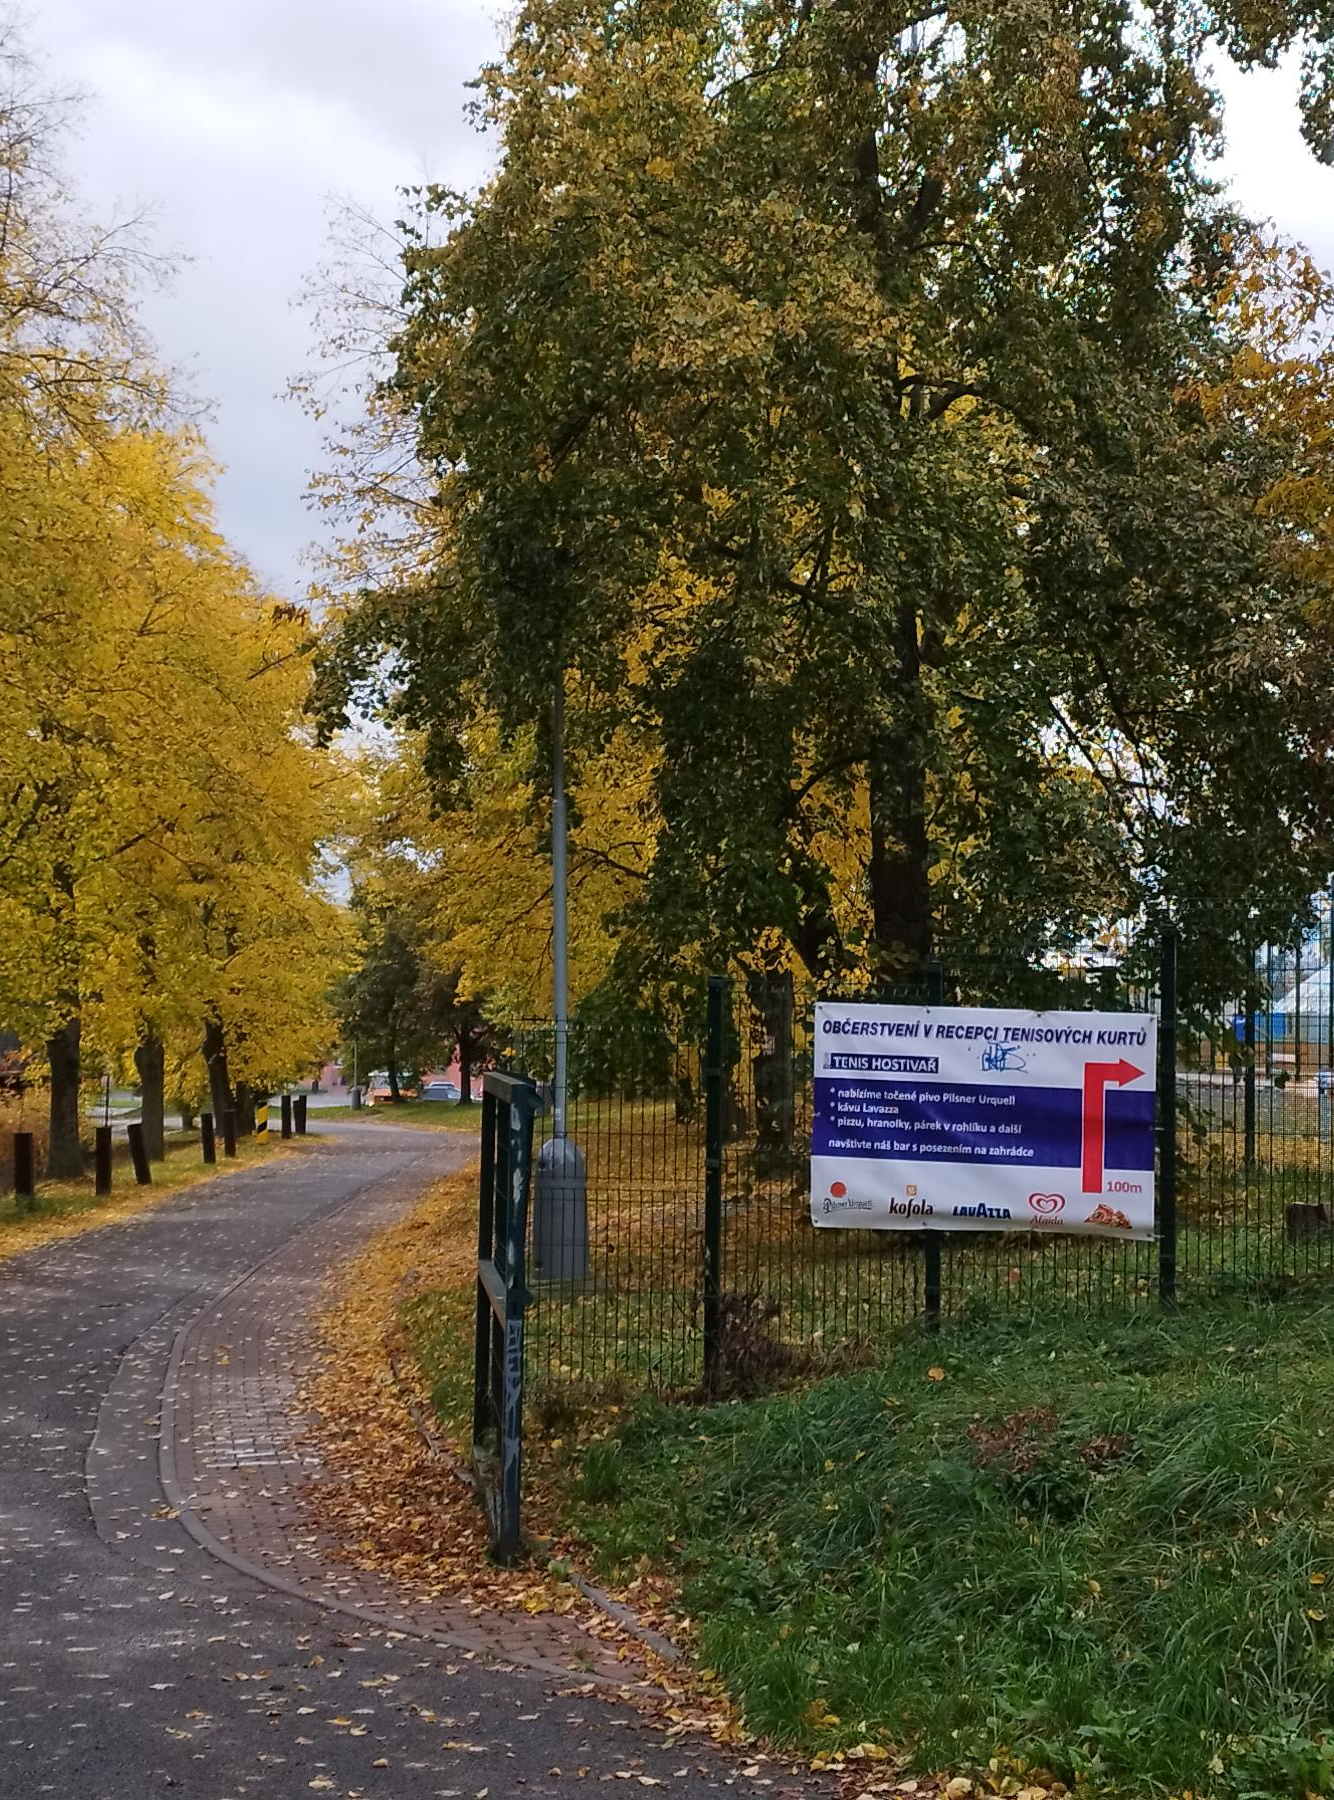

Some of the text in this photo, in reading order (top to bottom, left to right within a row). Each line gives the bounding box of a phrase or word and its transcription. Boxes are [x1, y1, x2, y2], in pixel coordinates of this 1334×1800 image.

[822, 1018, 1147, 1046] OBČERSTVENÍ V RECEPCI TENISOVÝCH KURTŮ
[833, 1056, 937, 1073] TENIS HOSTIVAŘ
[837, 1088, 1016, 1107] nabízíme točené pivo Pilsner Urquell
[837, 1102, 899, 1114] kávu Lavazza
[837, 1117, 1022, 1134] pizzu, hranolky, párek v rohlíku a další
[873, 1139, 892, 1150] náš
[893, 1140, 909, 1151] bar
[911, 1144, 918, 1152] s
[919, 1143, 972, 1154] posezením
[974, 1147, 987, 1155] na
[988, 1146, 1035, 1157] zahrádce
[1106, 1181, 1143, 1194] 100m
[888, 1197, 934, 1219] kofola
[952, 1202, 1012, 1220] LAVAZZA
